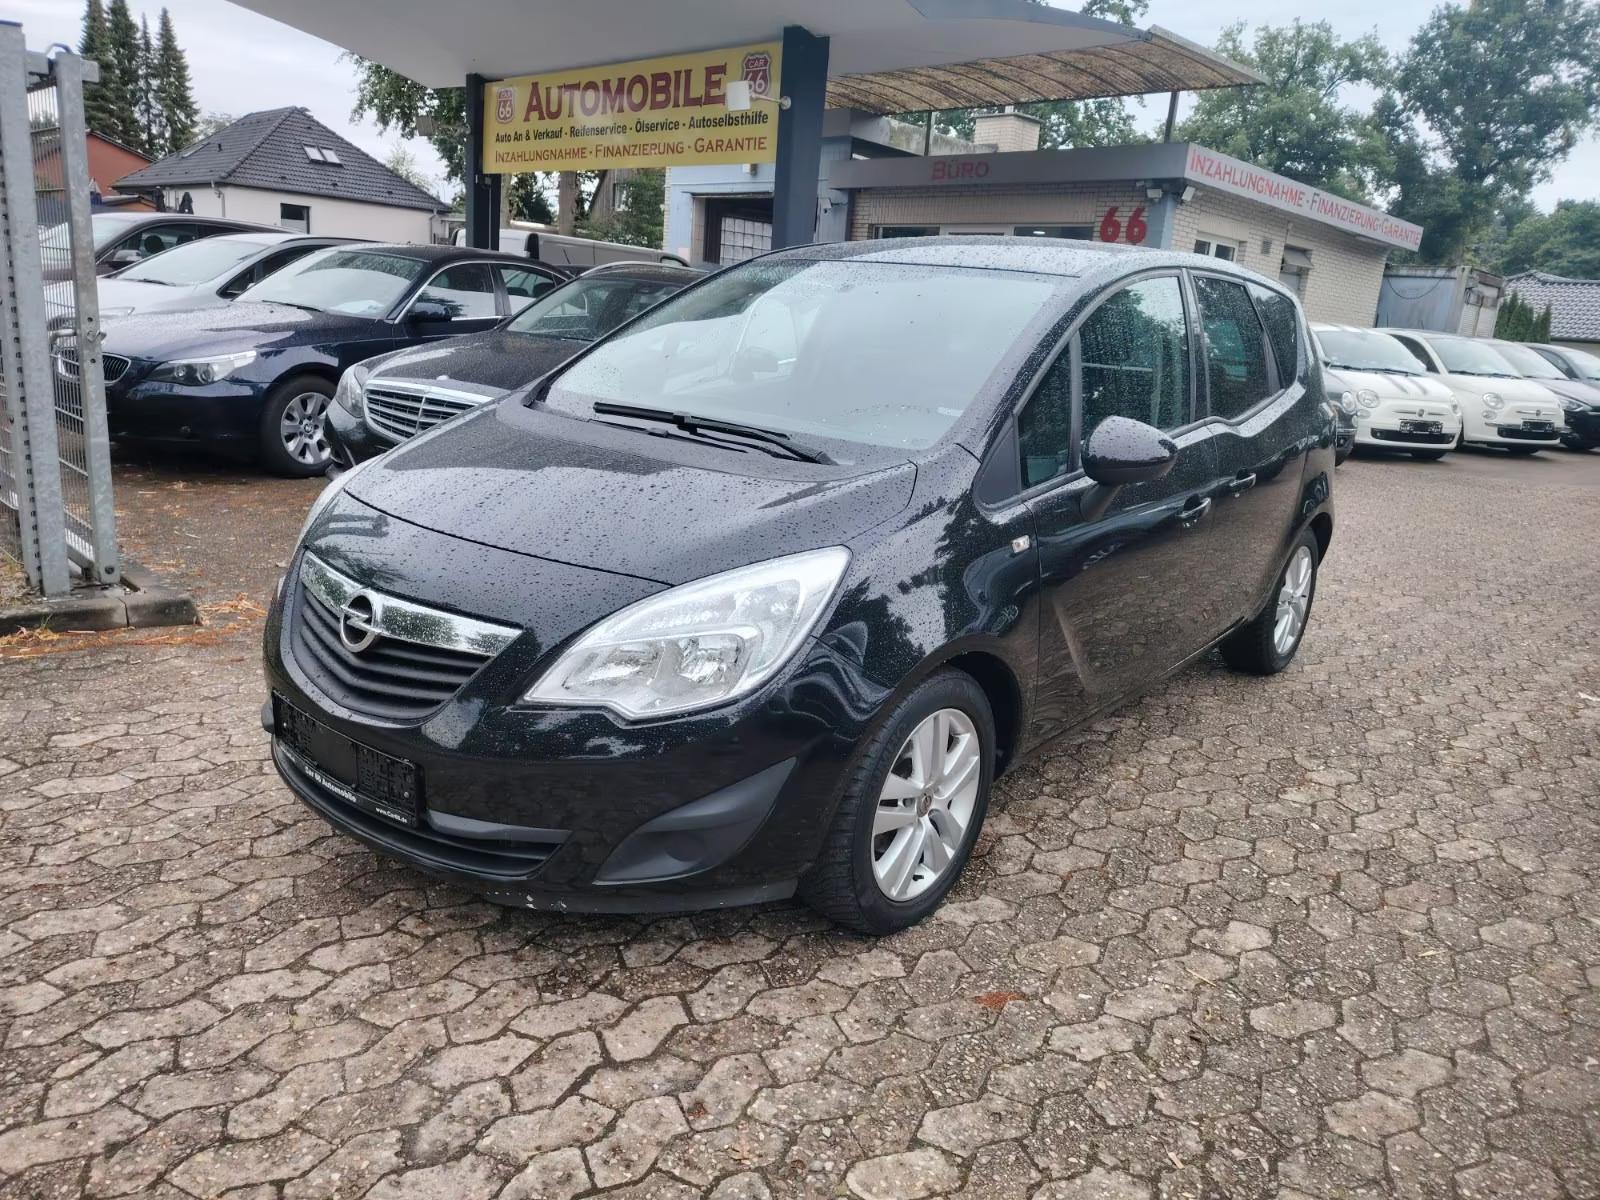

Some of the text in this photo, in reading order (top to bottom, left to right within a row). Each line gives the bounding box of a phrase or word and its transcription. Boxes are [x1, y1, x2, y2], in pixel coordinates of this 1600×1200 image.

[748, 59, 765, 69] CAR
[523, 62, 728, 122] AUTOMOBILE
[747, 71, 766, 94] 66
[499, 101, 512, 118] 66
[495, 110, 769, 143] Auto An & Verkauf Reifenservice Ölservice Autoselbsthilfe
[495, 137, 768, 163] INZAHLUNGNAHME FINANZIERUNG GARANTIE
[931, 159, 990, 180] BÜRO
[1190, 149, 1306, 207] INZAHLUNGNAHME
[1310, 192, 1379, 231] FINANZIERUNG
[1100, 206, 1147, 244] 66
